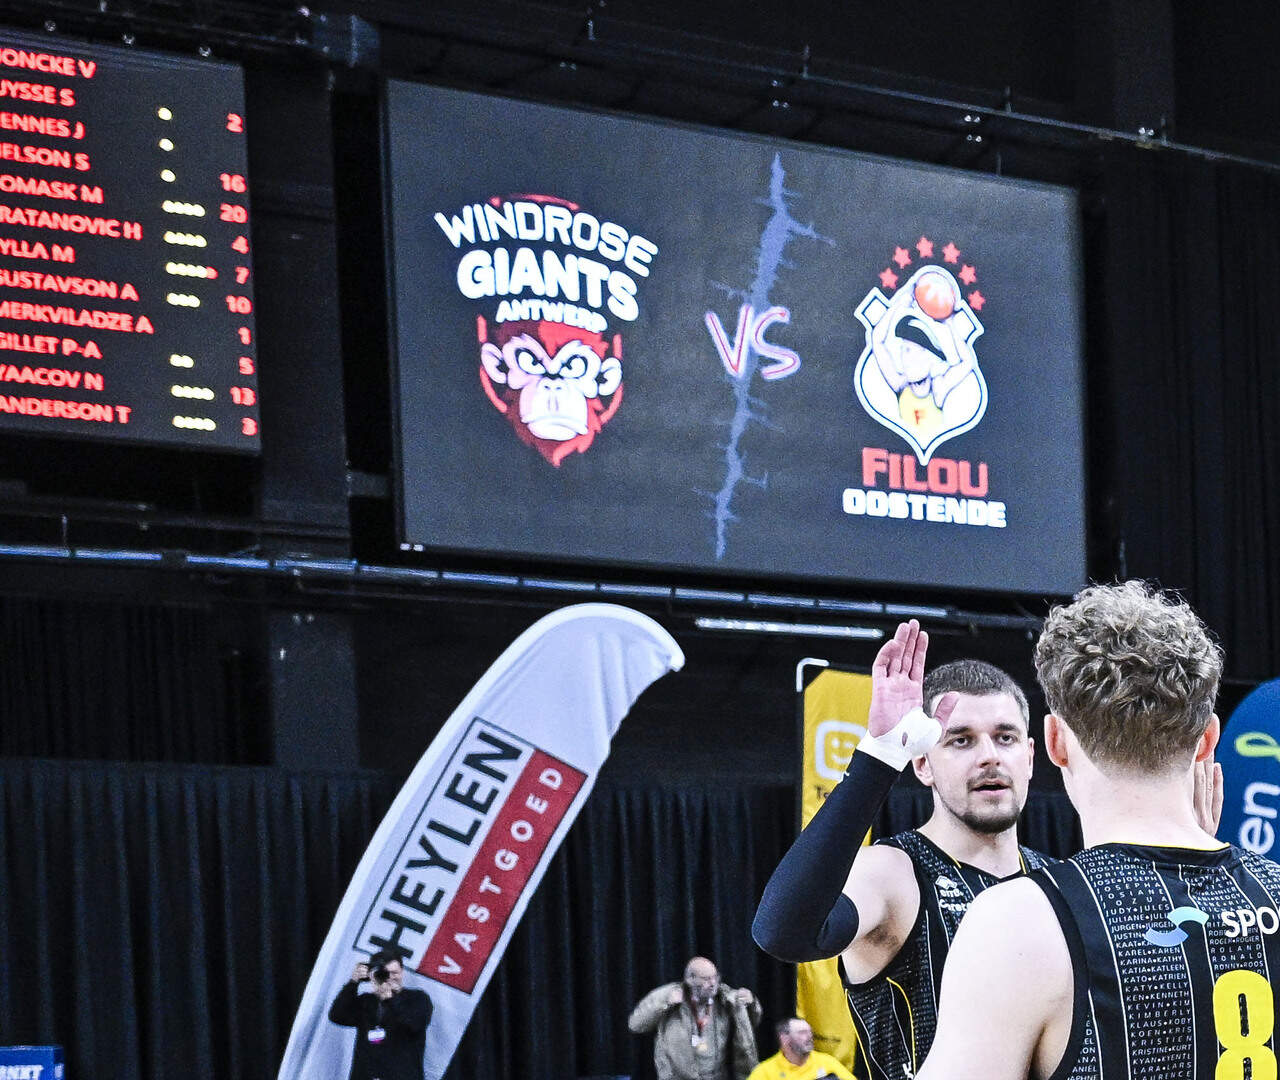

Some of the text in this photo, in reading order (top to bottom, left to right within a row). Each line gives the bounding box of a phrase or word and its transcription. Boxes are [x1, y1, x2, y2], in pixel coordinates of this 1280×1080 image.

[0, 48, 96, 79] ONCKE V
[60, 88, 76, 107] S
[226, 112, 243, 133] 2
[73, 121, 85, 140] J
[0, 142, 247, 193] ELSON S 16
[80, 184, 104, 204] M
[219, 202, 248, 224] 20
[122, 221, 143, 240] H
[231, 235, 249, 254] 4
[434, 201, 659, 278] WINDROSE
[51, 243, 76, 263] M
[235, 264, 249, 284] 7
[120, 283, 140, 302] A
[226, 294, 252, 315] 10
[457, 247, 640, 322] GIANTS
[135, 315, 154, 334] A
[238, 325, 251, 344] 1
[495, 299, 608, 332] ANTWERP
[61, 338, 103, 359] P-A
[238, 356, 255, 375] 5
[705, 303, 800, 381] VS
[83, 371, 104, 391] N
[229, 385, 256, 407] 13
[114, 404, 131, 424] T
[241, 415, 258, 436] 3
[862, 446, 988, 498] FILOU
[842, 488, 1007, 528] OOSTENDE
[364, 729, 523, 966] HEYLEN
[438, 767, 564, 975] VASTGOED
